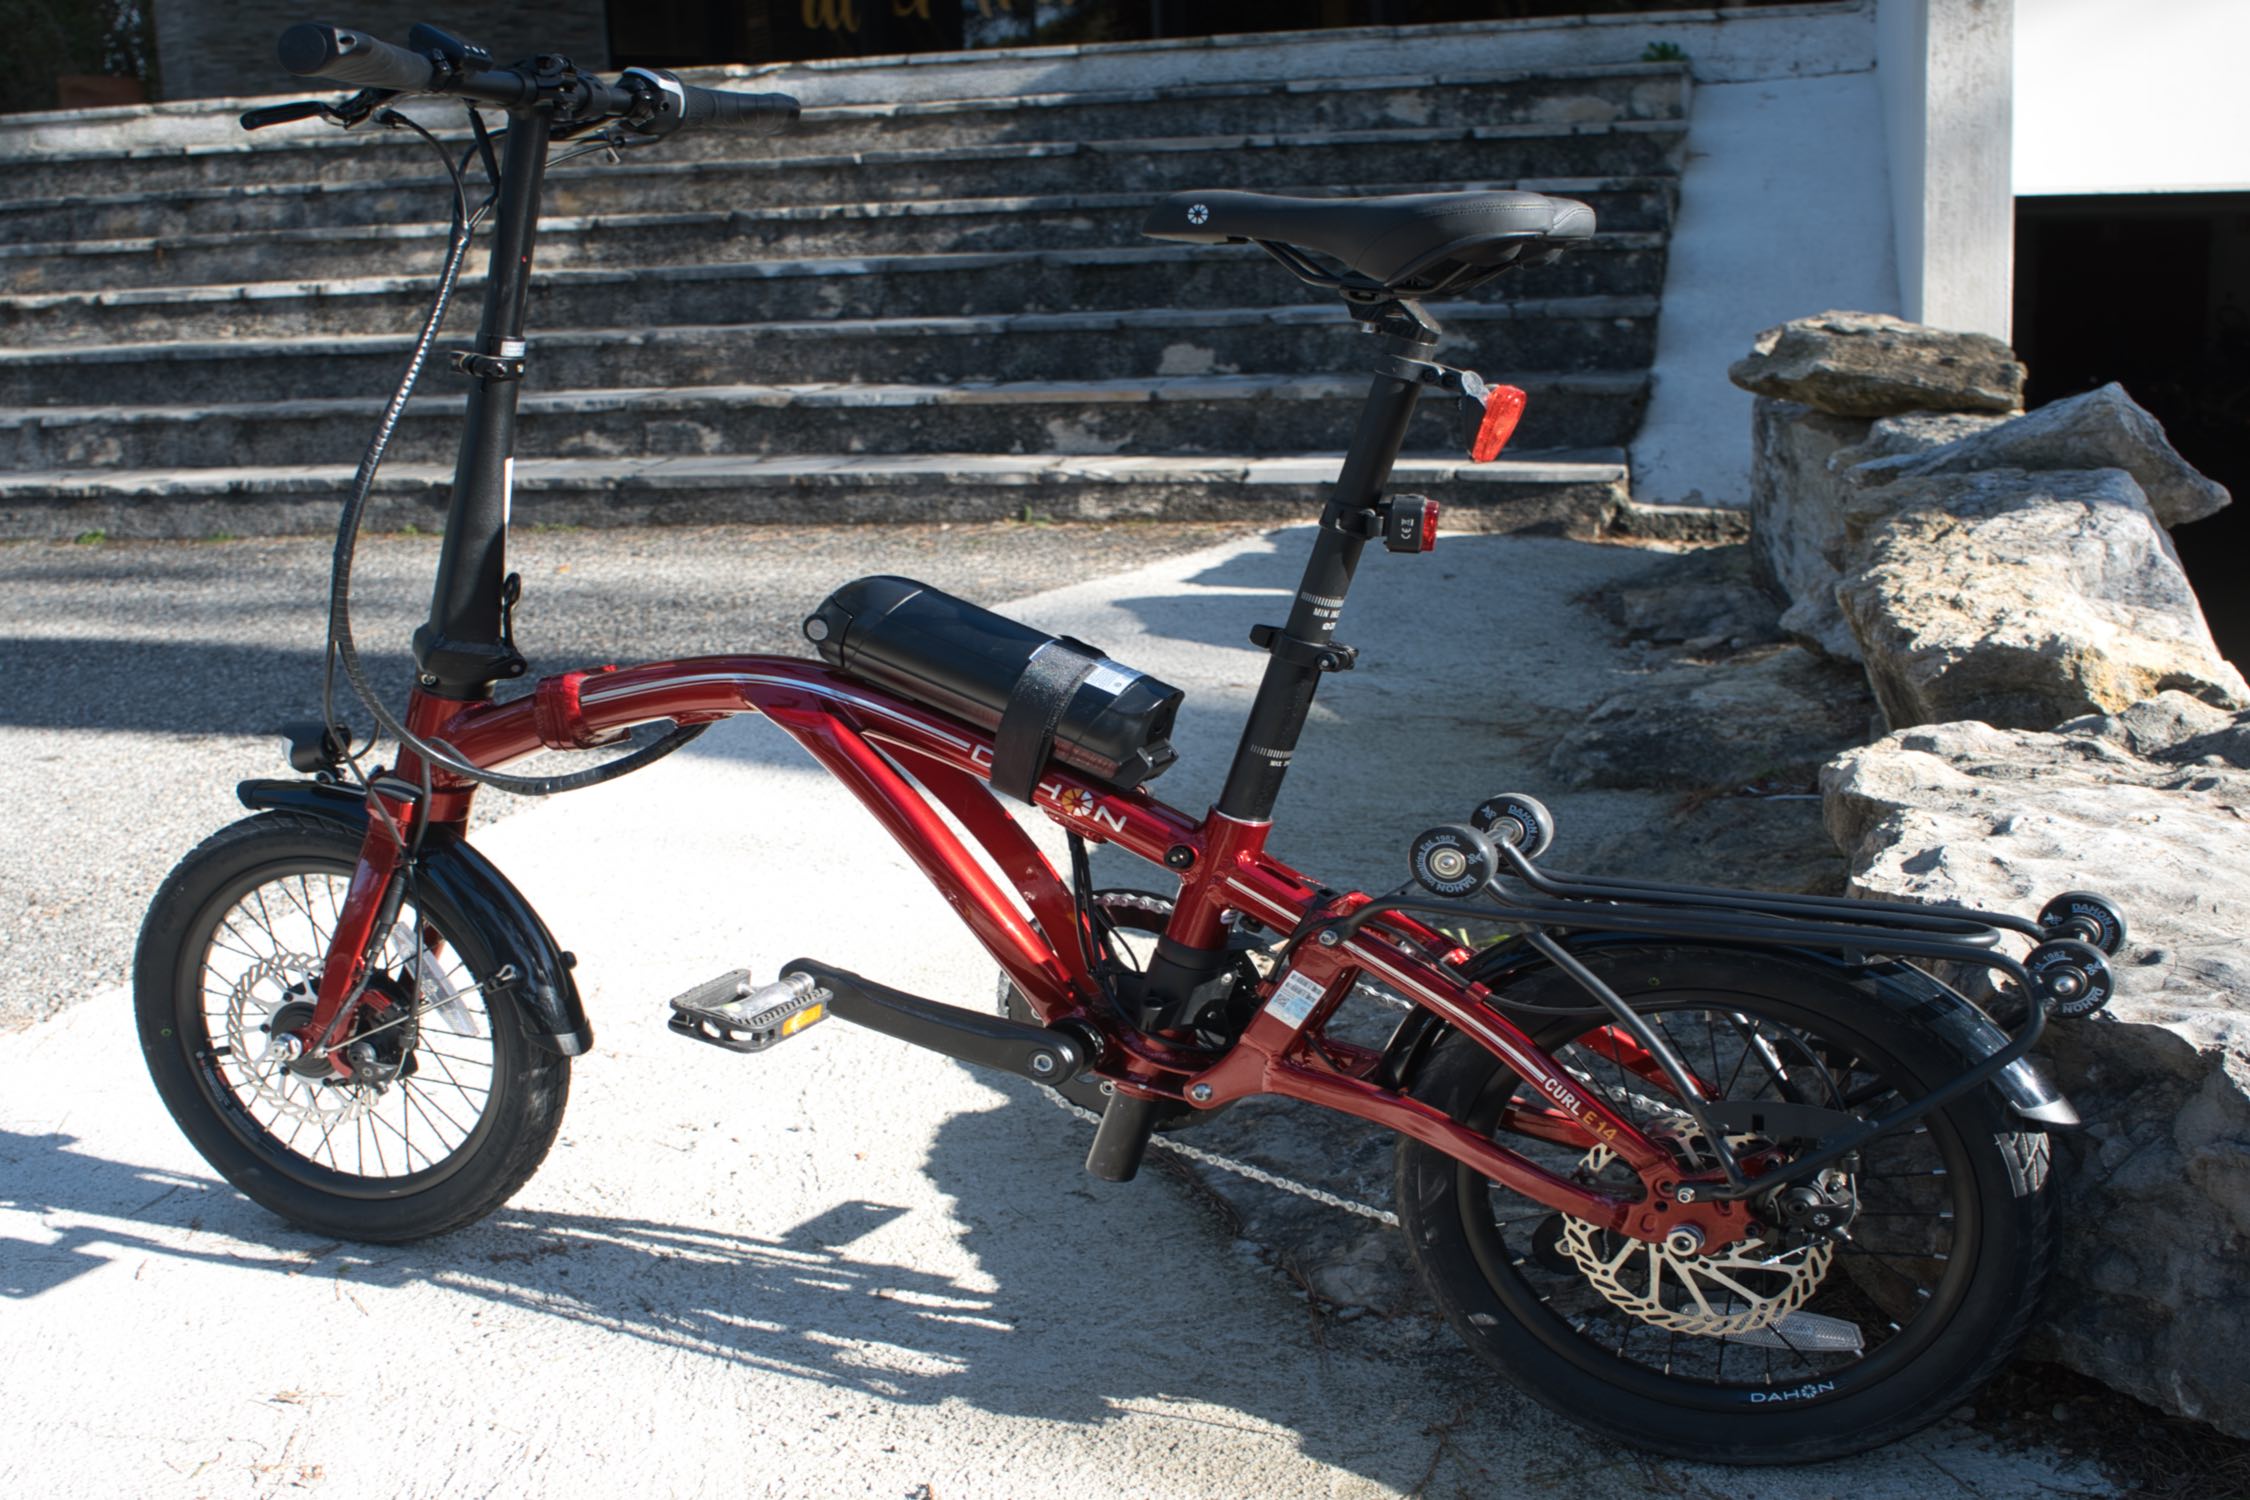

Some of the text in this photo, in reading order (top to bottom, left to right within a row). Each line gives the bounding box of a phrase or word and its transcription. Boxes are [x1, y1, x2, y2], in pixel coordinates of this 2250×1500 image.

[1313, 608, 1330, 618] MIN
[970, 743, 1128, 833] DHON
[1507, 803, 1539, 834] DAHON
[1436, 874, 1478, 893] DAHON
[2071, 903, 2114, 926] DAHON
[2043, 950, 2066, 961] 1982
[2084, 963, 2098, 976] 96
[2062, 985, 2105, 1014] DAHON
[1544, 1078, 1617, 1141] CURL E 14
[1750, 1380, 1835, 1403] DAHON
